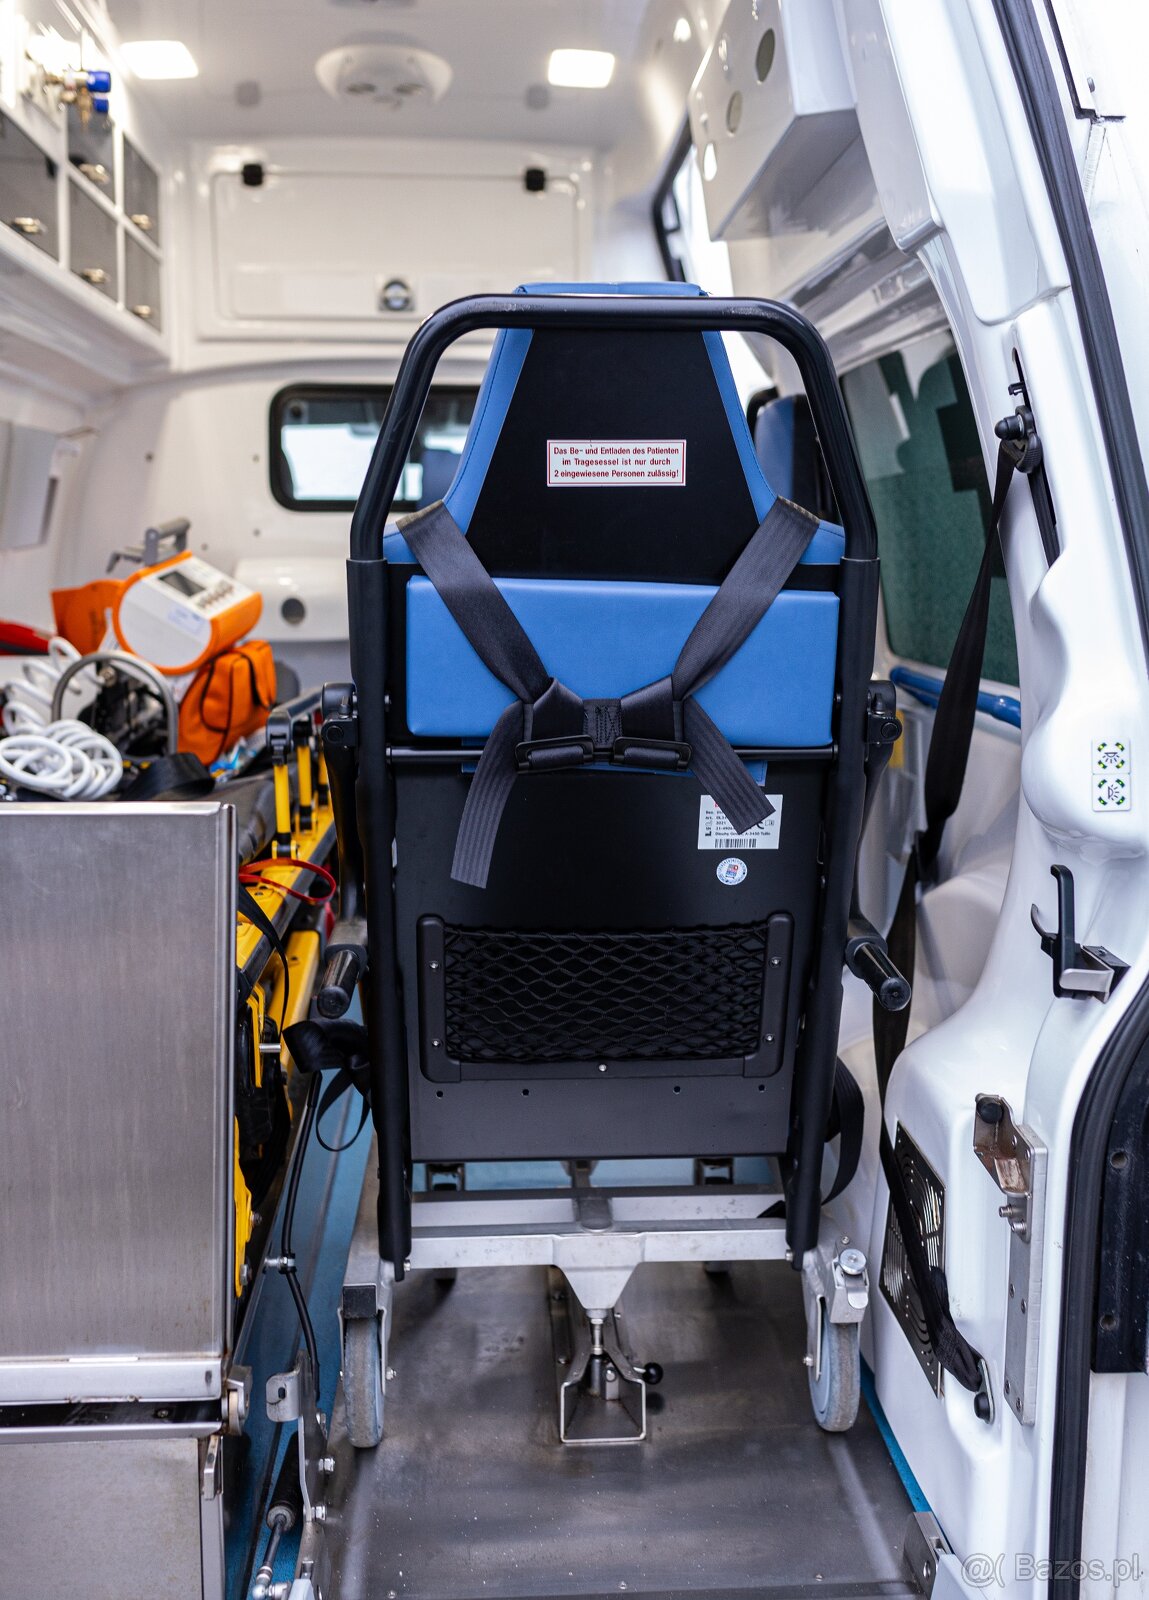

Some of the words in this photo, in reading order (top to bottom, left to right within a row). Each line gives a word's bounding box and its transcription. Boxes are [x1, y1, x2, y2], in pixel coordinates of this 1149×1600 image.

[553, 447, 568, 455] Das
[569, 447, 583, 455] Be-
[585, 447, 598, 455] und
[600, 447, 630, 455] Entladen
[632, 447, 645, 455] des
[647, 447, 679, 455] Patienten
[574, 458, 619, 467] Tragesessel
[560, 470, 609, 478] eingewiesene
[647, 469, 679, 478] zulässig!
